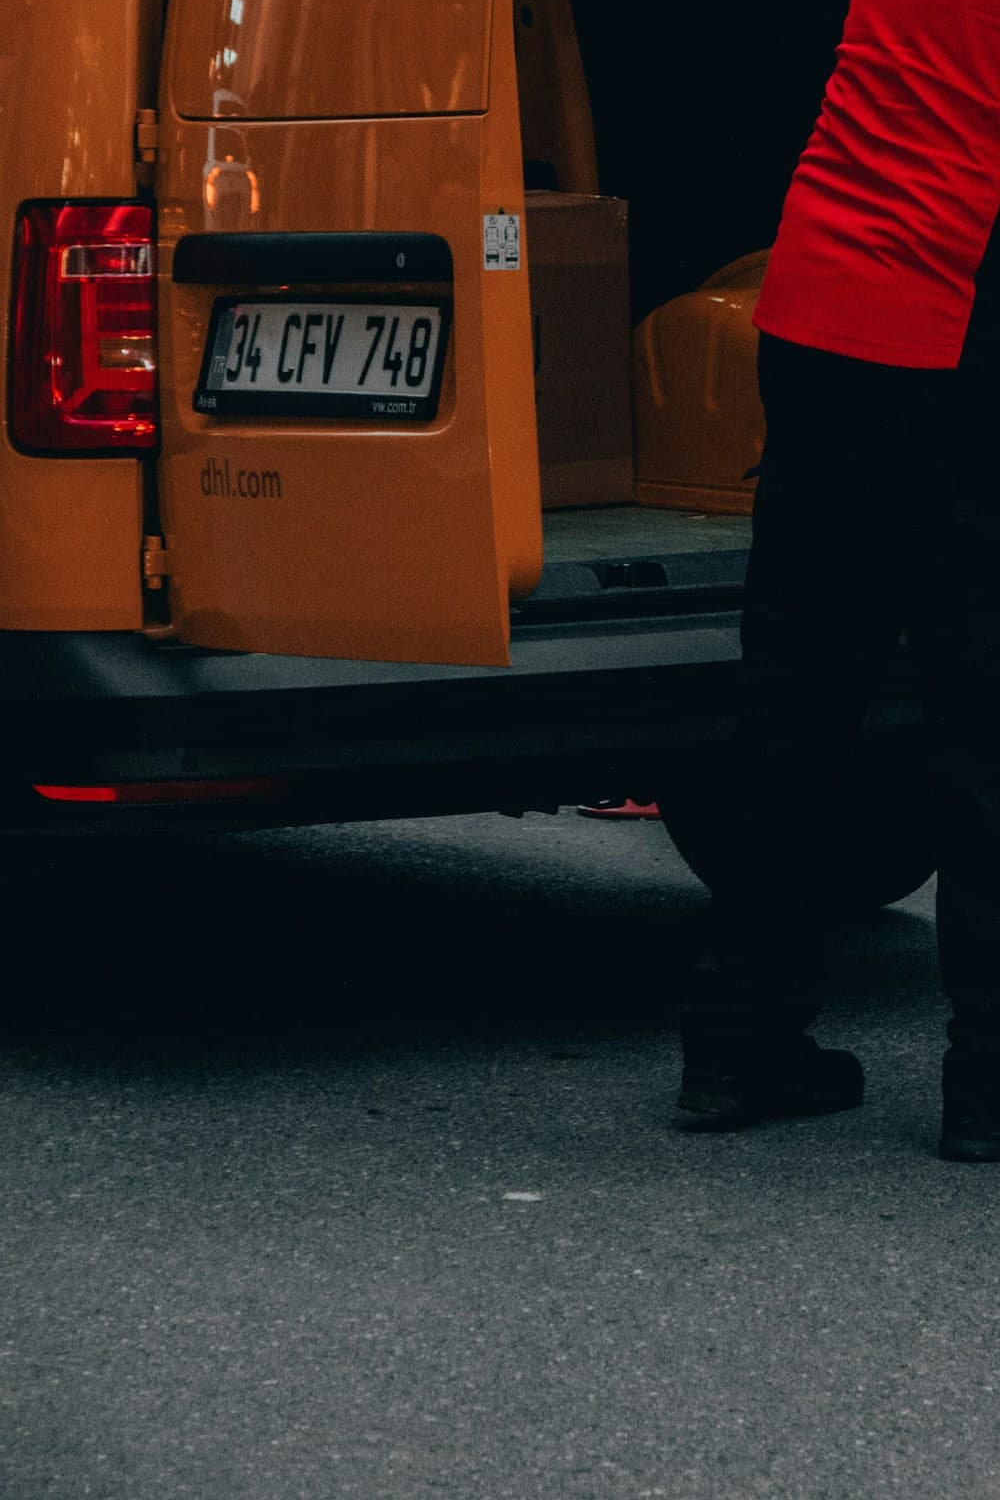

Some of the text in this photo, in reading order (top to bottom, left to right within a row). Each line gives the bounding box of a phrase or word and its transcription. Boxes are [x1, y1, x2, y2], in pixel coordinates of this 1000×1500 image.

[226, 314, 261, 382] 34
[277, 314, 344, 384] CFV
[358, 316, 431, 387] 748
[372, 401, 417, 414] vw.com.tr
[201, 457, 282, 498] dhl.com
